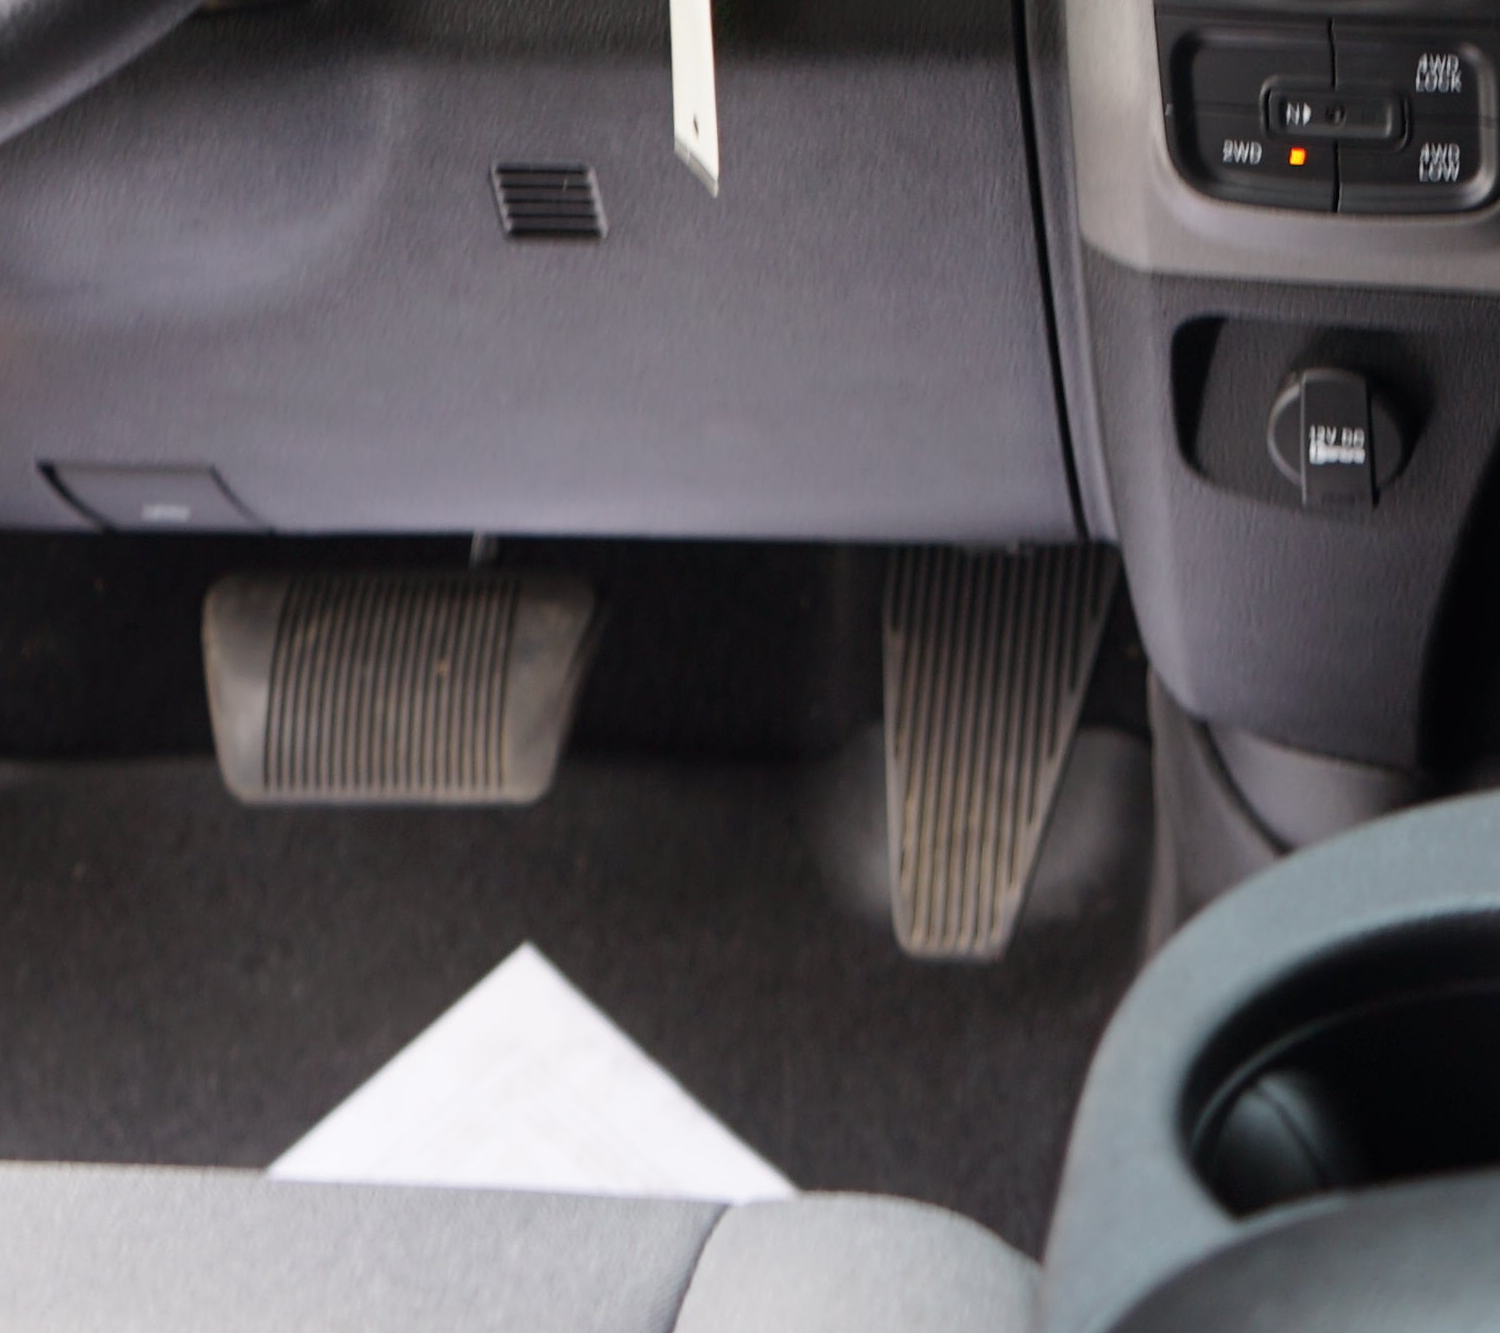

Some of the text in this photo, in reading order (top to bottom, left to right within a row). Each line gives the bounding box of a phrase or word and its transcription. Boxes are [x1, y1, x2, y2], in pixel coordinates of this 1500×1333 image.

[1417, 53, 1460, 75] 4WD
[1415, 71, 1462, 93] LOCK
[1222, 139, 1263, 164] 2WD
[1419, 143, 1460, 164] 4WD
[1419, 160, 1460, 182] LOW
